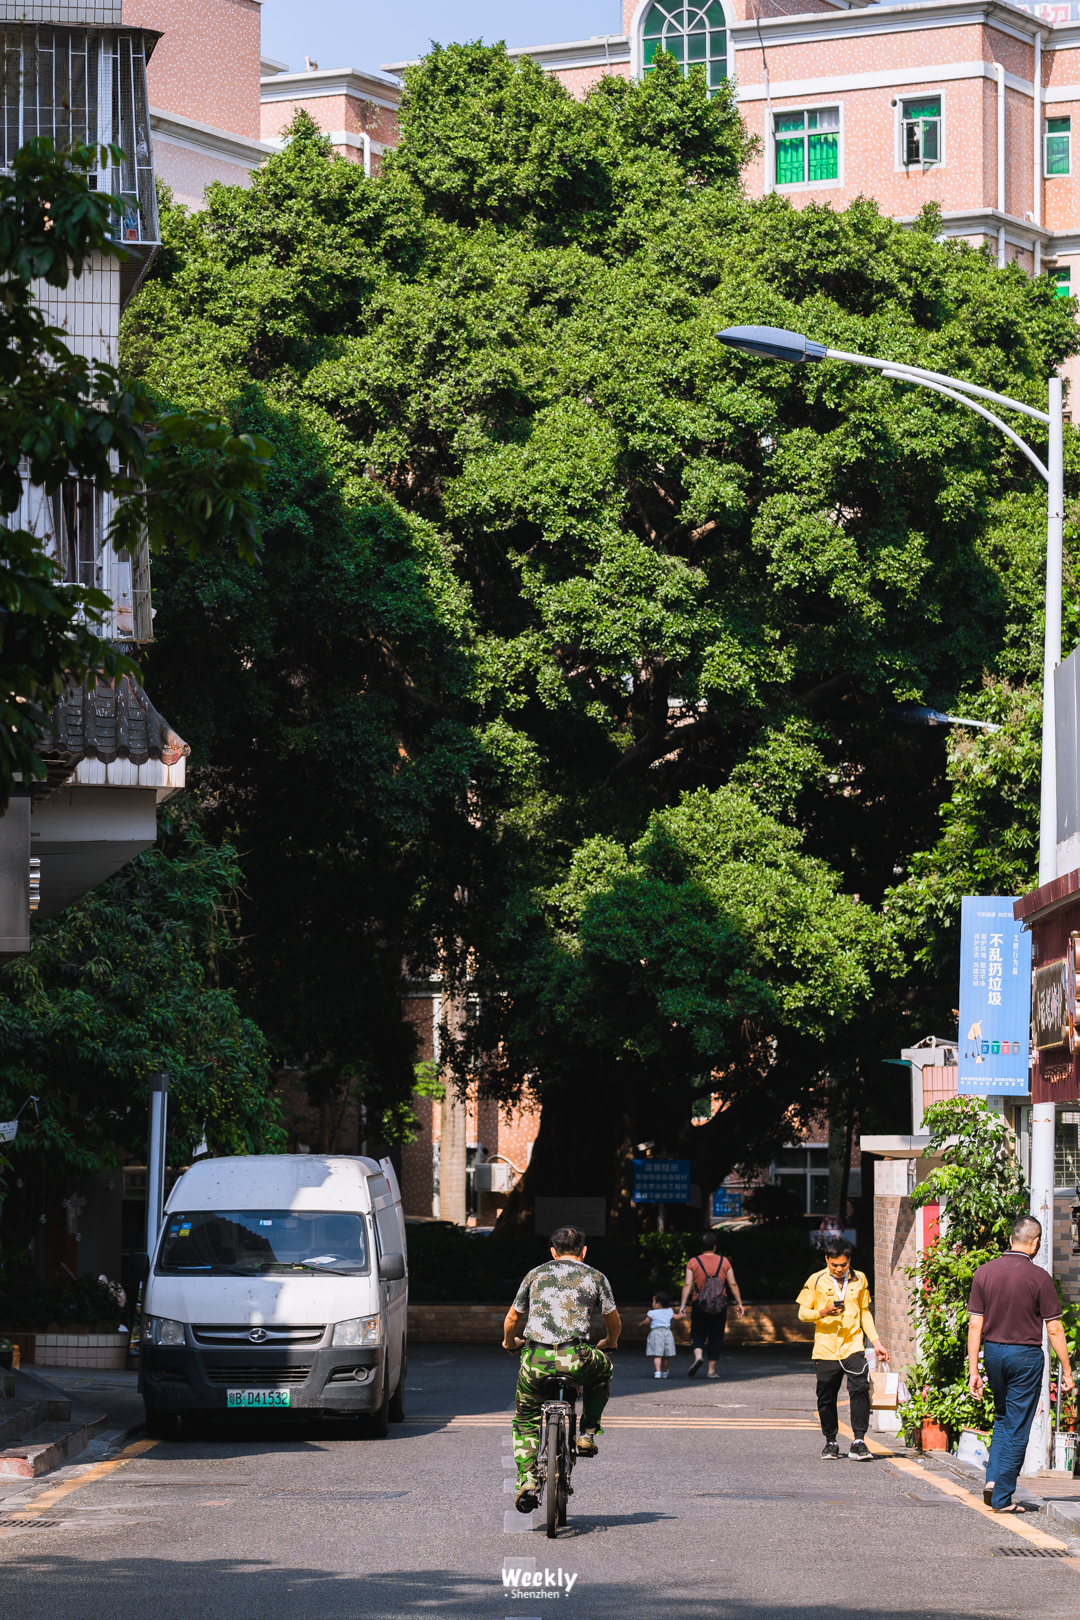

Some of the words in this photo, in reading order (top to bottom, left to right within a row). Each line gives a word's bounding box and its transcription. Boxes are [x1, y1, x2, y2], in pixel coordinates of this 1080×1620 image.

[987, 933, 1004, 1006] 不乱扔垃圾
[644, 1163, 679, 1172] 温馨提示
